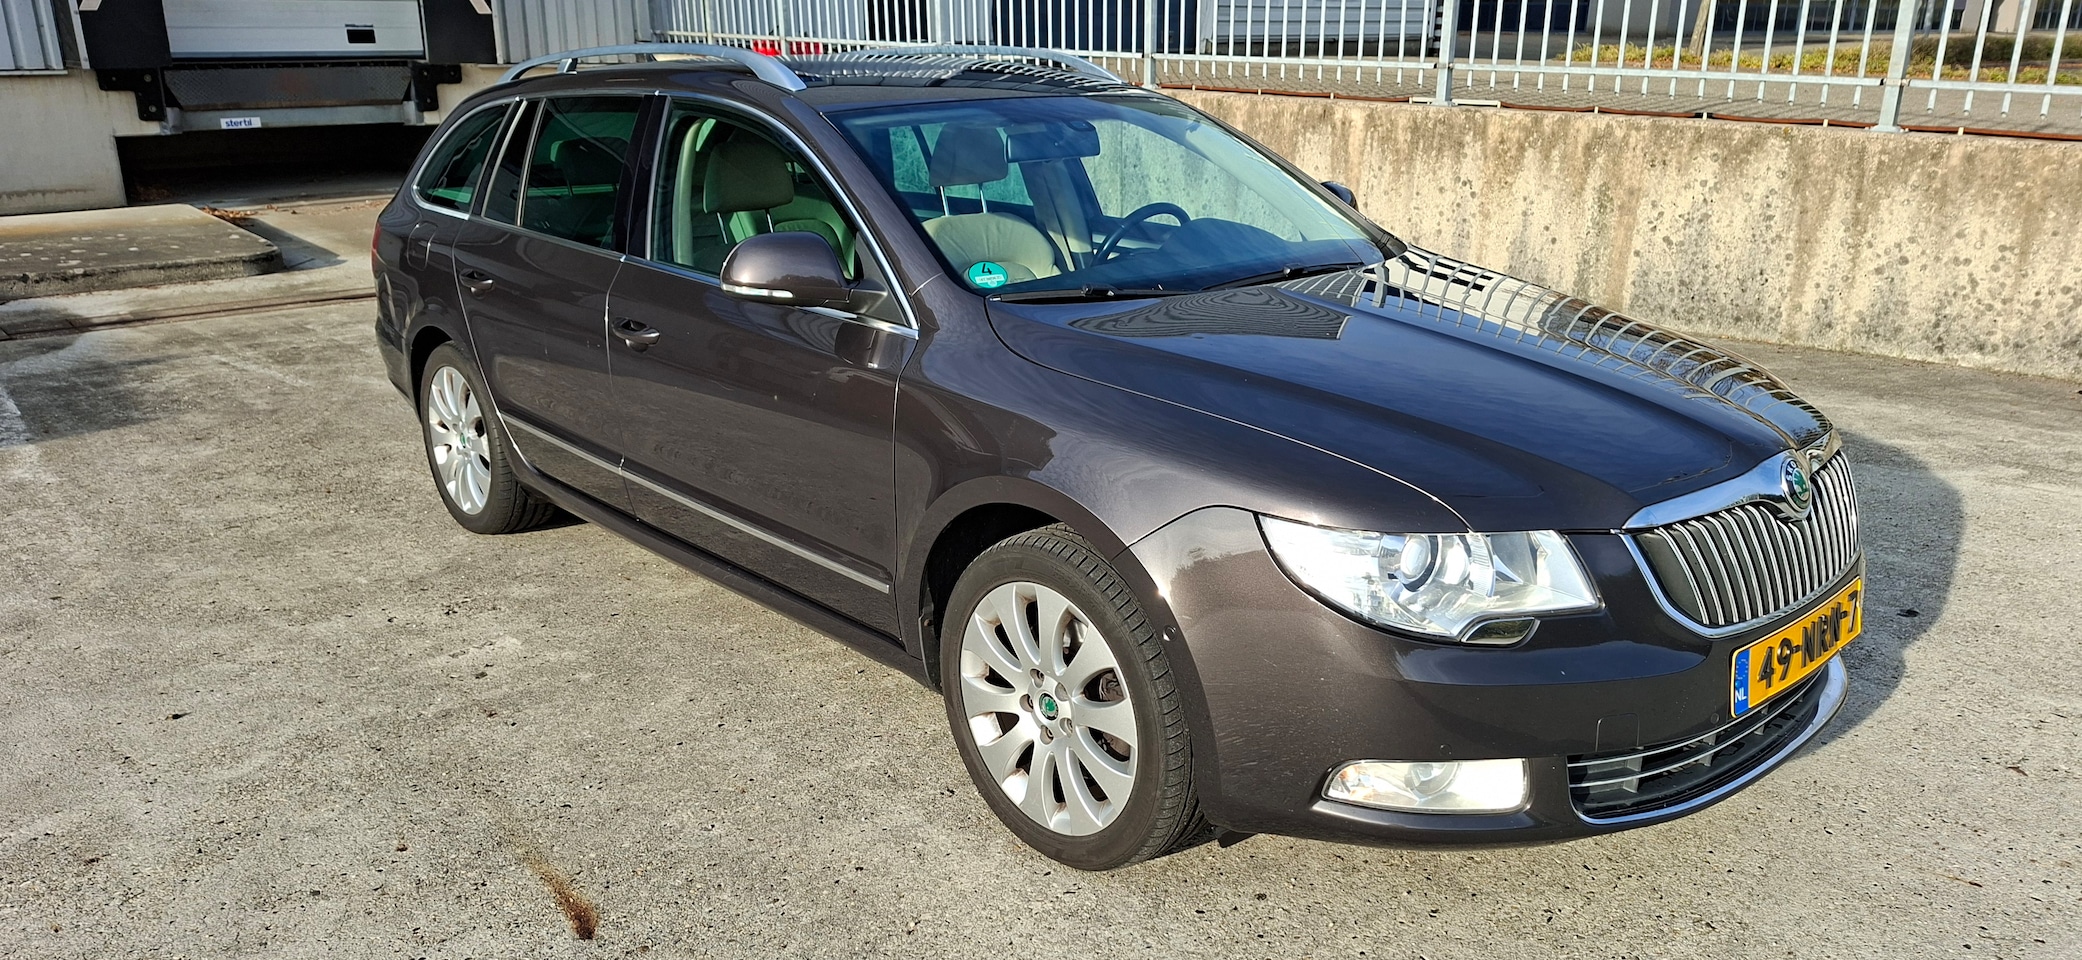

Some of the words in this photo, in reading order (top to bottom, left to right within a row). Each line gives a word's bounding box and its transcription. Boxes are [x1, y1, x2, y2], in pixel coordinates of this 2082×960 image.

[225, 118, 252, 127] stertil
[982, 263, 992, 275] 4
[1757, 590, 1859, 689] 49-NRN-7
[1735, 686, 1747, 703] NL
